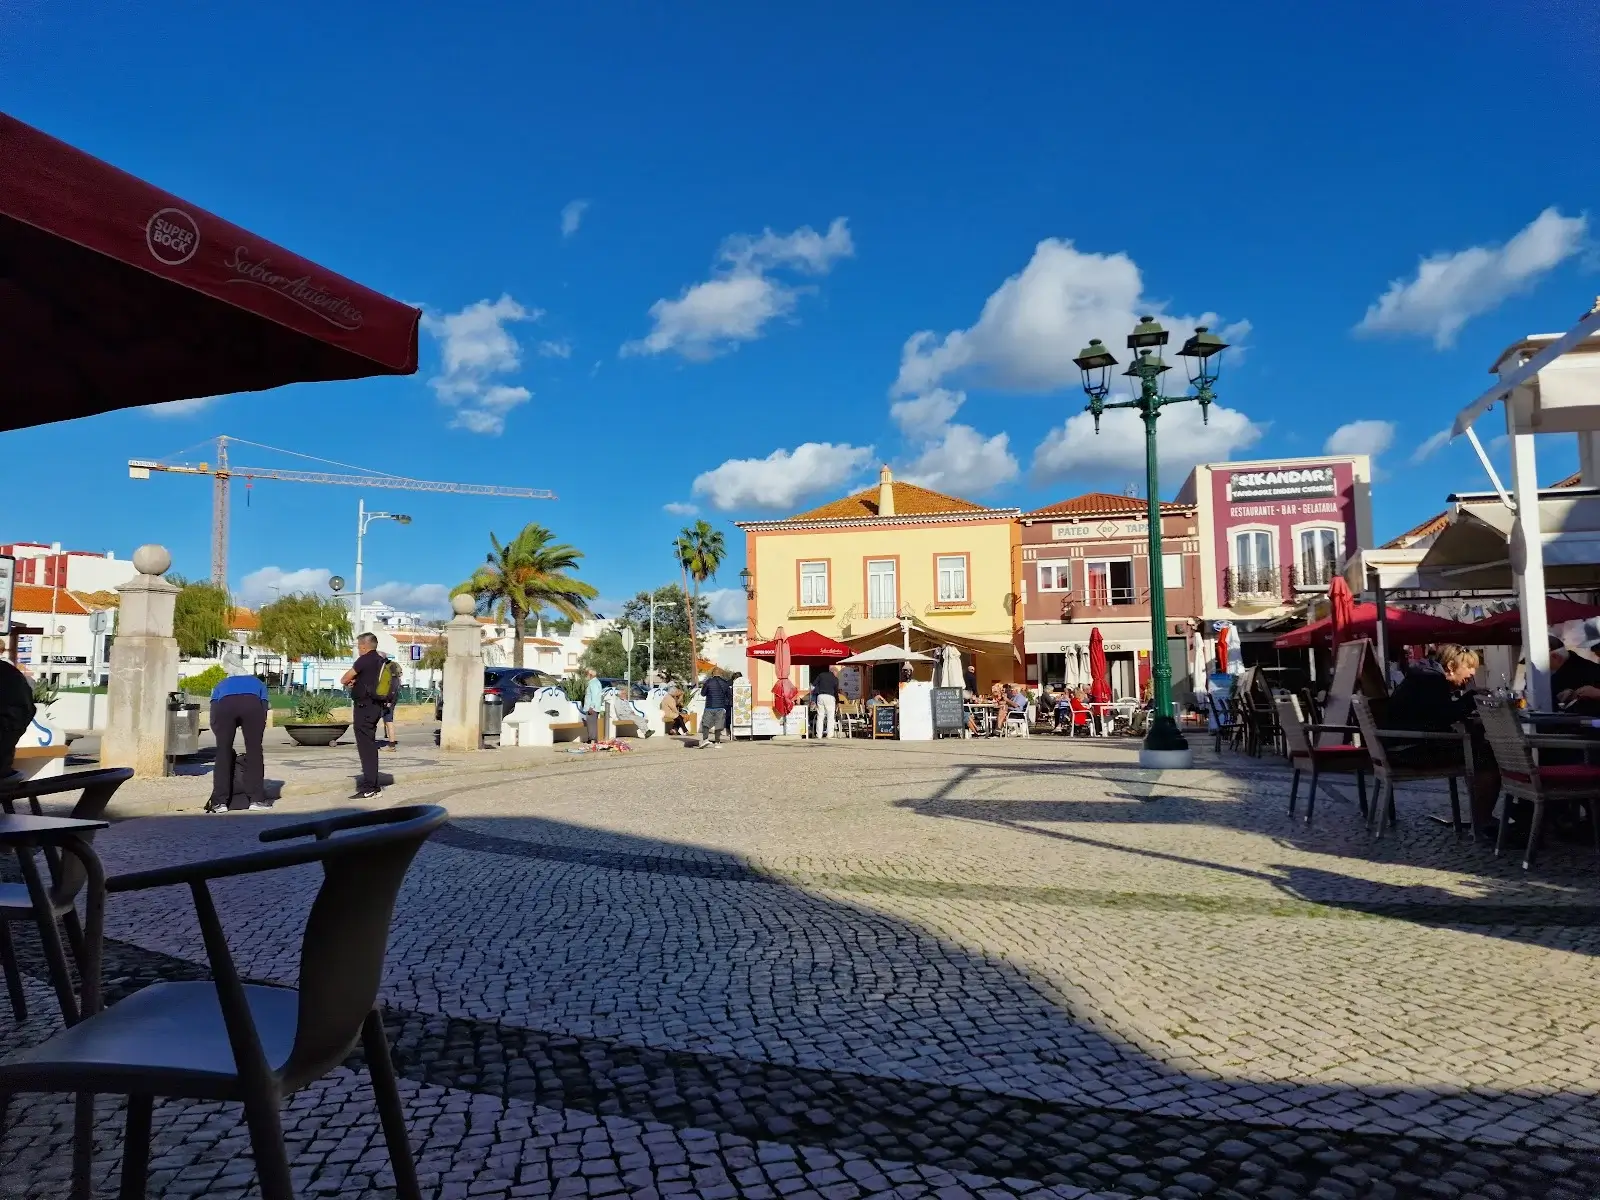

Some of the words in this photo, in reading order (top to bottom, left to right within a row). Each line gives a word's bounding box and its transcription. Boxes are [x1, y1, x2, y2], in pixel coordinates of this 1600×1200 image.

[154, 218, 194, 244] SUPER
[153, 230, 188, 254] BOCK
[223, 245, 285, 285] Sabor
[1238, 469, 1325, 486] SIKANDAR
[1273, 487, 1301, 495] INDIAN
[1230, 505, 1275, 517] RESTAURANTE
[1281, 504, 1297, 515] BAR
[1302, 502, 1338, 514] GELATARIA
[1125, 523, 1149, 533] TAPA
